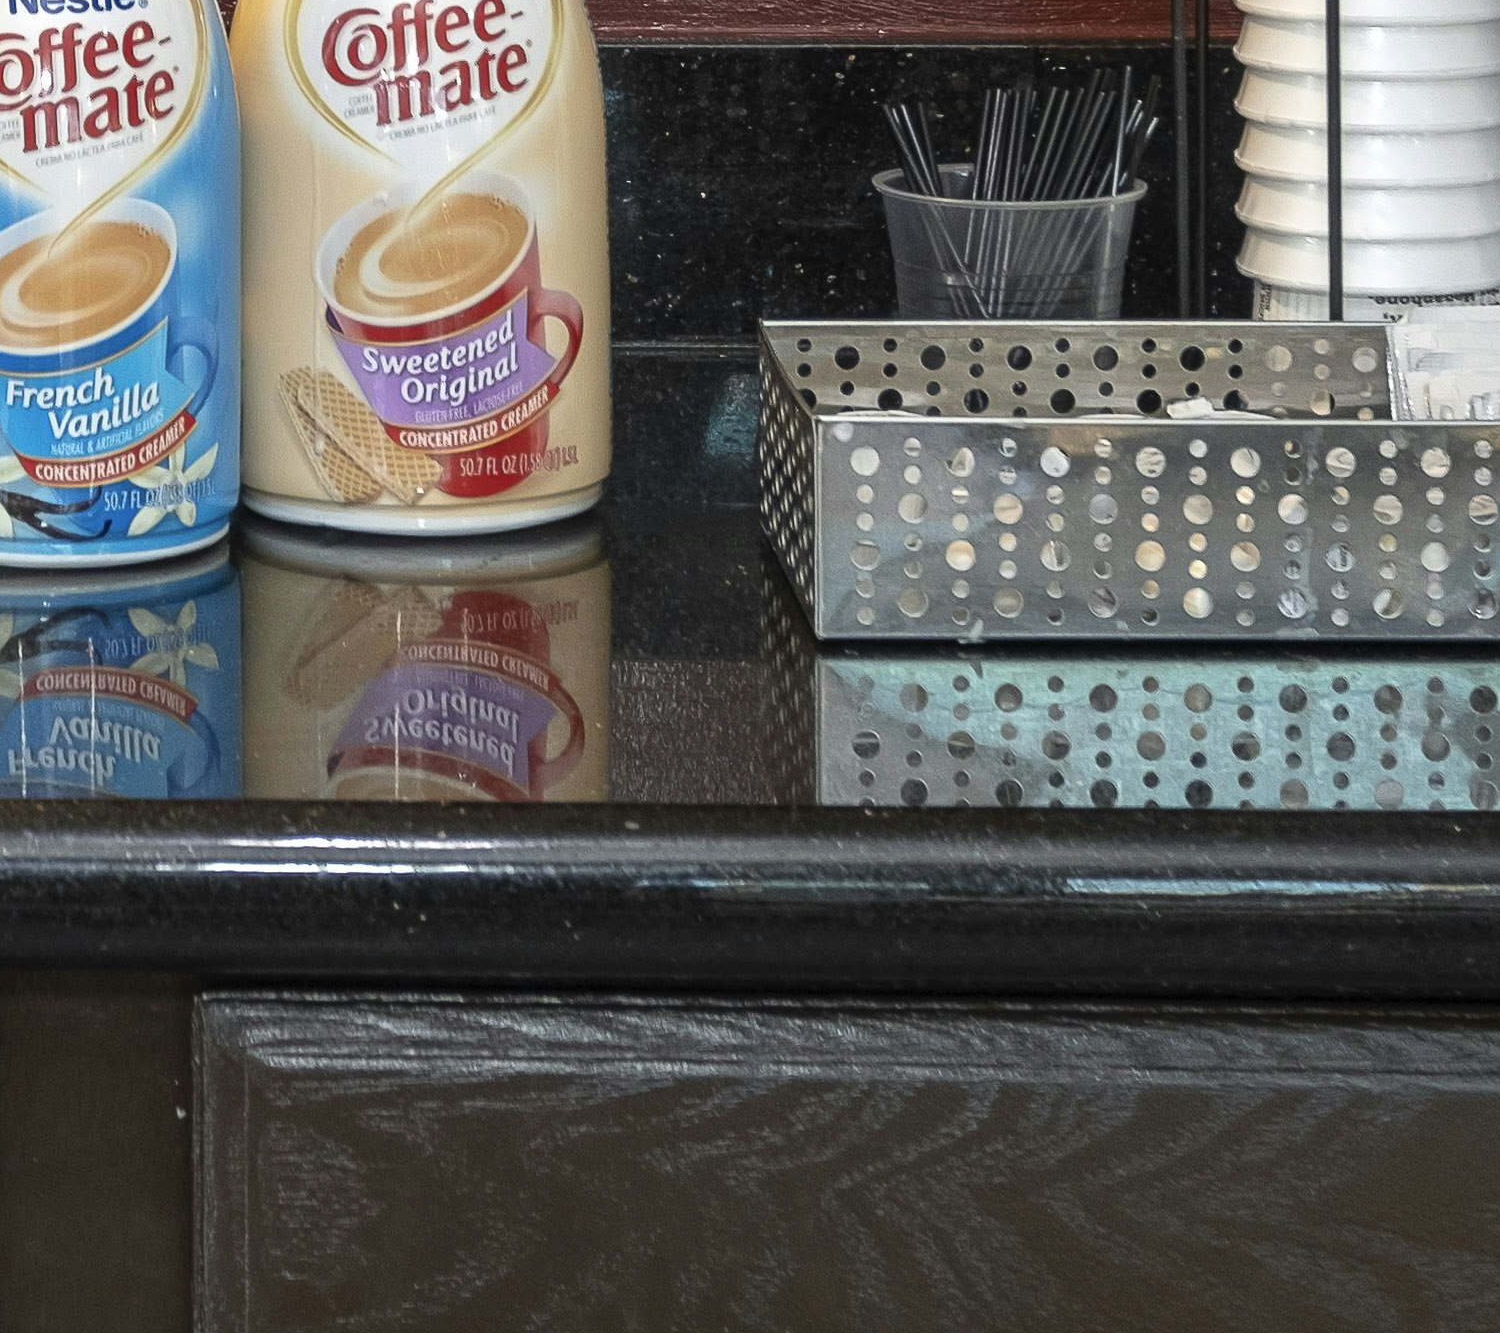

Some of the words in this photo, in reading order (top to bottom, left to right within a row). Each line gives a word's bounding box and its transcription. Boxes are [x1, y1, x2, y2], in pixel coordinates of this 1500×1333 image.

[20, 70, 176, 153] mate
[374, 42, 529, 127] mate
[362, 309, 514, 375] Sweetened
[401, 342, 519, 406] Original
[6, 366, 115, 409] French
[48, 381, 160, 440] Vanilla
[400, 420, 498, 449] CONCENTRATED
[501, 385, 549, 431] CREAMER
[35, 455, 136, 483] CONCENTRATED
[138, 416, 186, 465] CREAMER
[460, 456, 482, 477] 50.7
[486, 456, 498, 477] FL
[501, 455, 518, 475] OZ
[104, 490, 128, 512] 50.7
[130, 489, 143, 509] FL
